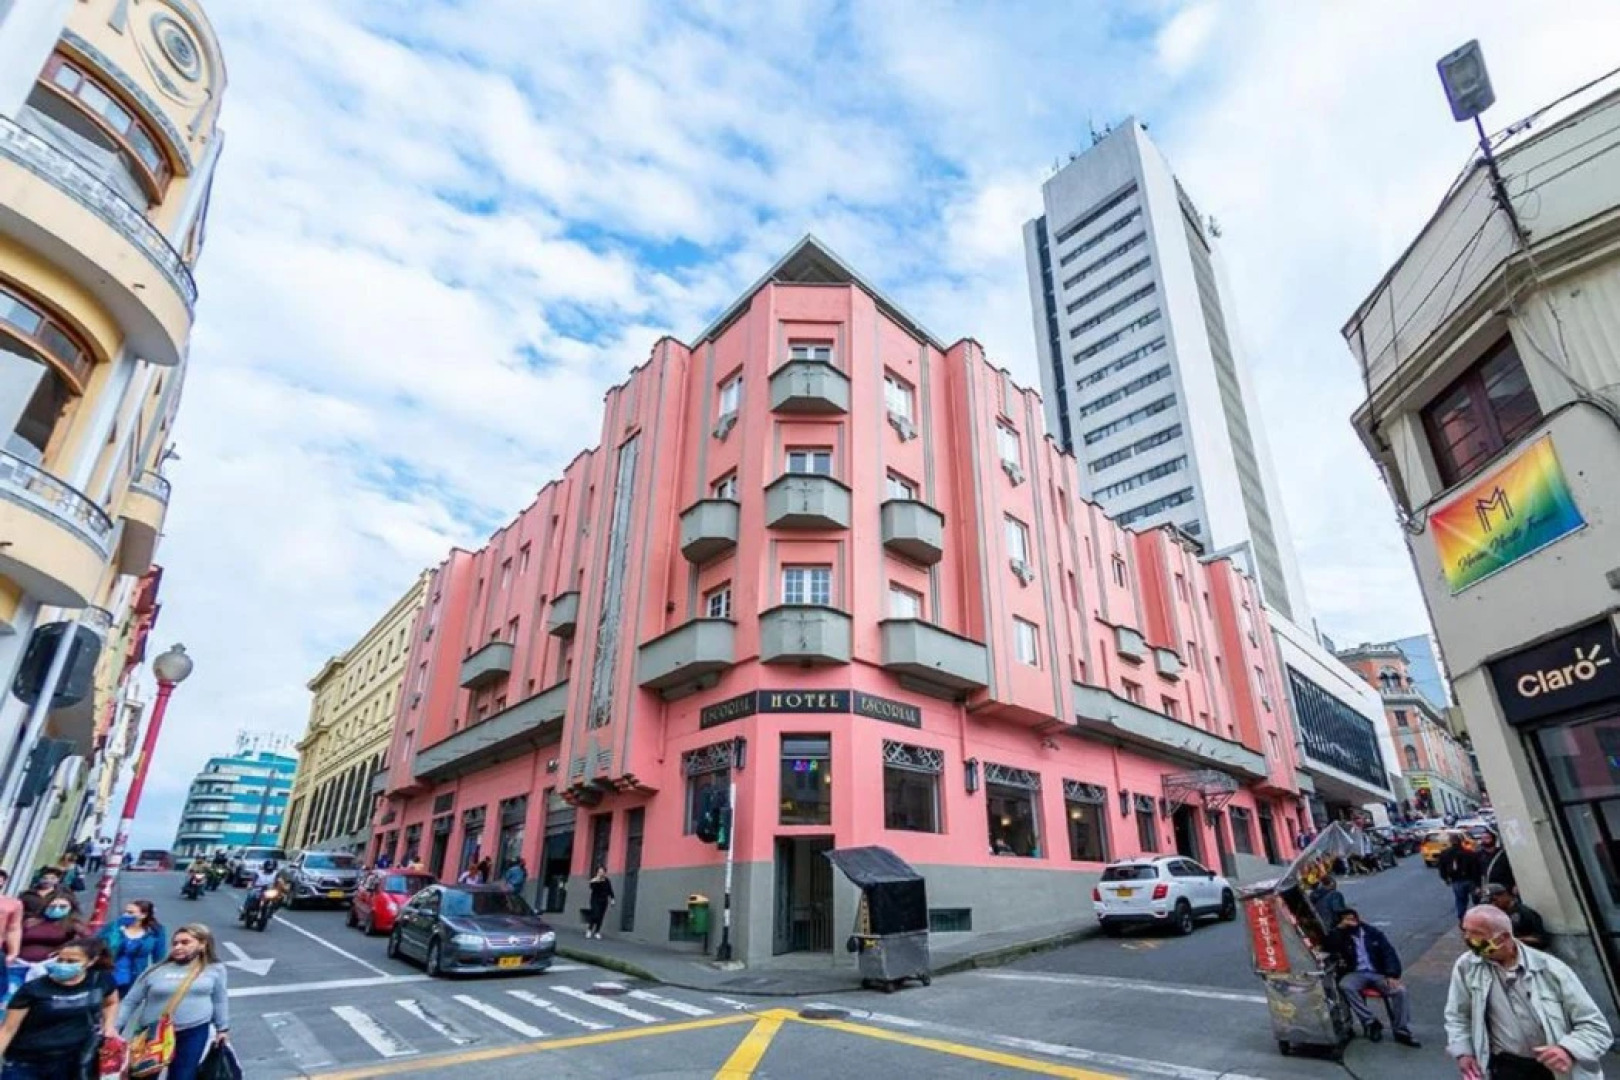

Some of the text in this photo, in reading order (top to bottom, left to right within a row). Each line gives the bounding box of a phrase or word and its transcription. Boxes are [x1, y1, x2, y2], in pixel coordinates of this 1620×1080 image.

[1517, 656, 1598, 698] Claro
[702, 696, 751, 724] ESCORIAL
[770, 693, 839, 709] HOTEL
[861, 696, 917, 723] ESCORIAL
